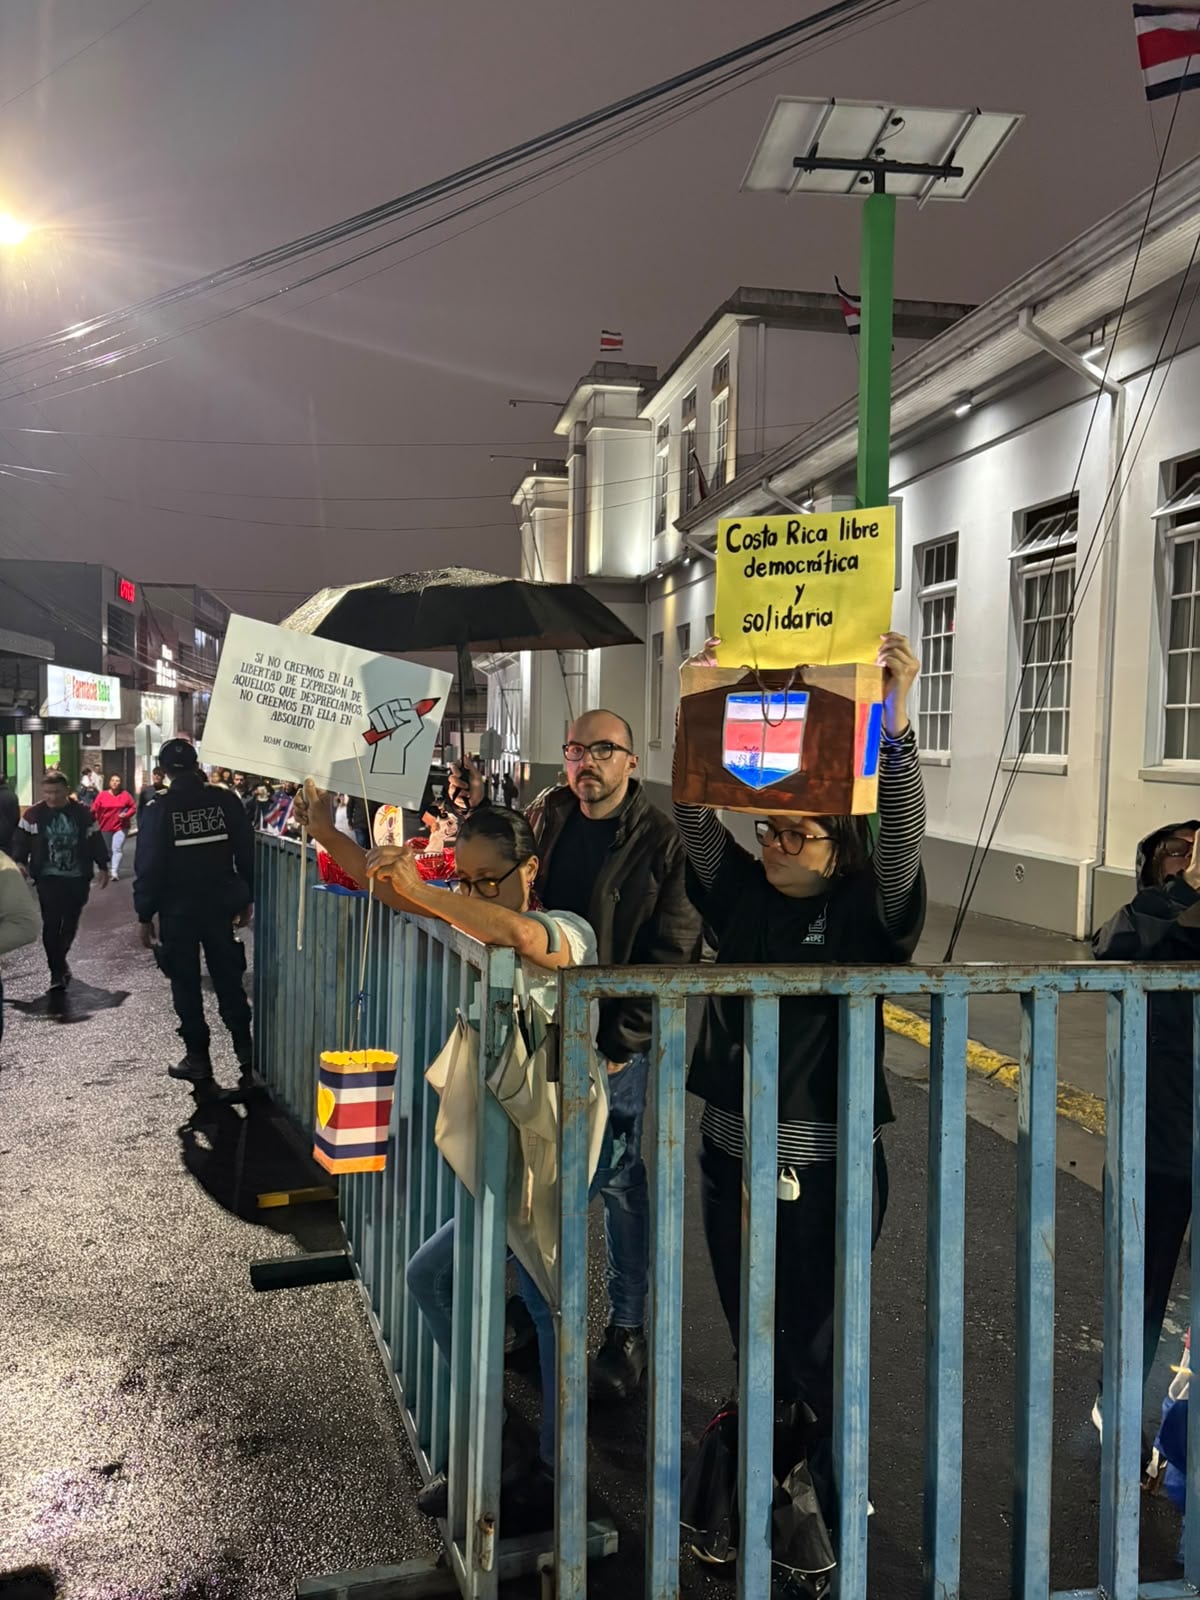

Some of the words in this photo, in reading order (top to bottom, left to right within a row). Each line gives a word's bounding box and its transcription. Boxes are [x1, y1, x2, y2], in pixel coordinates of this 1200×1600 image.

[726, 523, 778, 553] Costa
[786, 520, 828, 546] Rica
[839, 516, 880, 541] libre
[743, 550, 859, 579] democrática
[794, 583, 805, 606] y
[742, 604, 833, 634] solidaria
[240, 662, 282, 681] LIBERTAD
[285, 673, 298, 686] DE
[350, 690, 363, 703] DE
[254, 652, 264, 664] SI
[267, 655, 281, 668] NO
[284, 660, 325, 680] CREEMOS
[327, 671, 341, 684] EN
[343, 675, 354, 688] LA
[232, 674, 276, 693] AQUELLOS
[279, 685, 297, 699] QUE
[239, 688, 254, 702] NO
[256, 693, 298, 712] CREEMOS
[301, 703, 314, 716] EN
[316, 708, 337, 723] ELLA
[339, 713, 353, 726] EN
[263, 735, 282, 747] NOAM
[172, 806, 225, 825] FUERZA
[174, 817, 227, 837] PUBLICA
